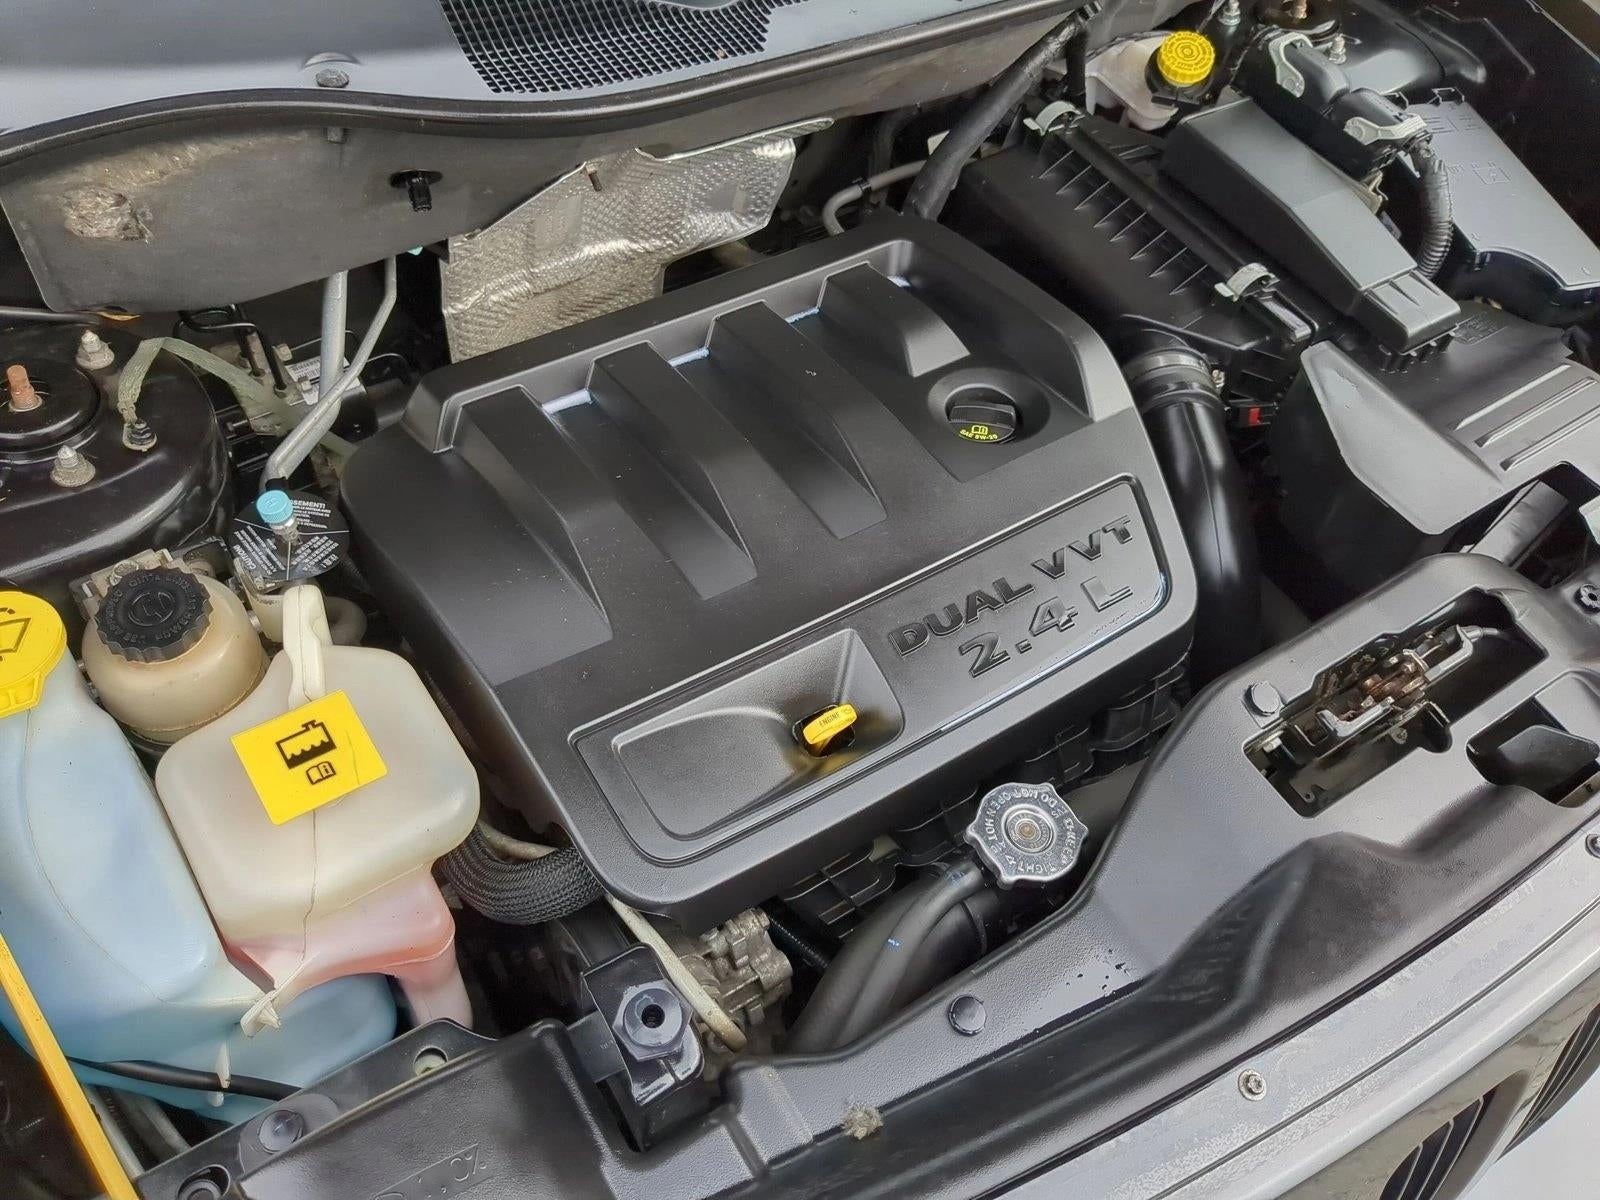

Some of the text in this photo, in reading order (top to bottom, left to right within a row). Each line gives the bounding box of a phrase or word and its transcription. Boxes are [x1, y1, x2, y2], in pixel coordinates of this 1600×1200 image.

[233, 545, 257, 570] CAUTION!
[888, 514, 1132, 659] DUAL VVT
[1041, 794, 1058, 808] DO
[985, 818, 998, 841] HOT
